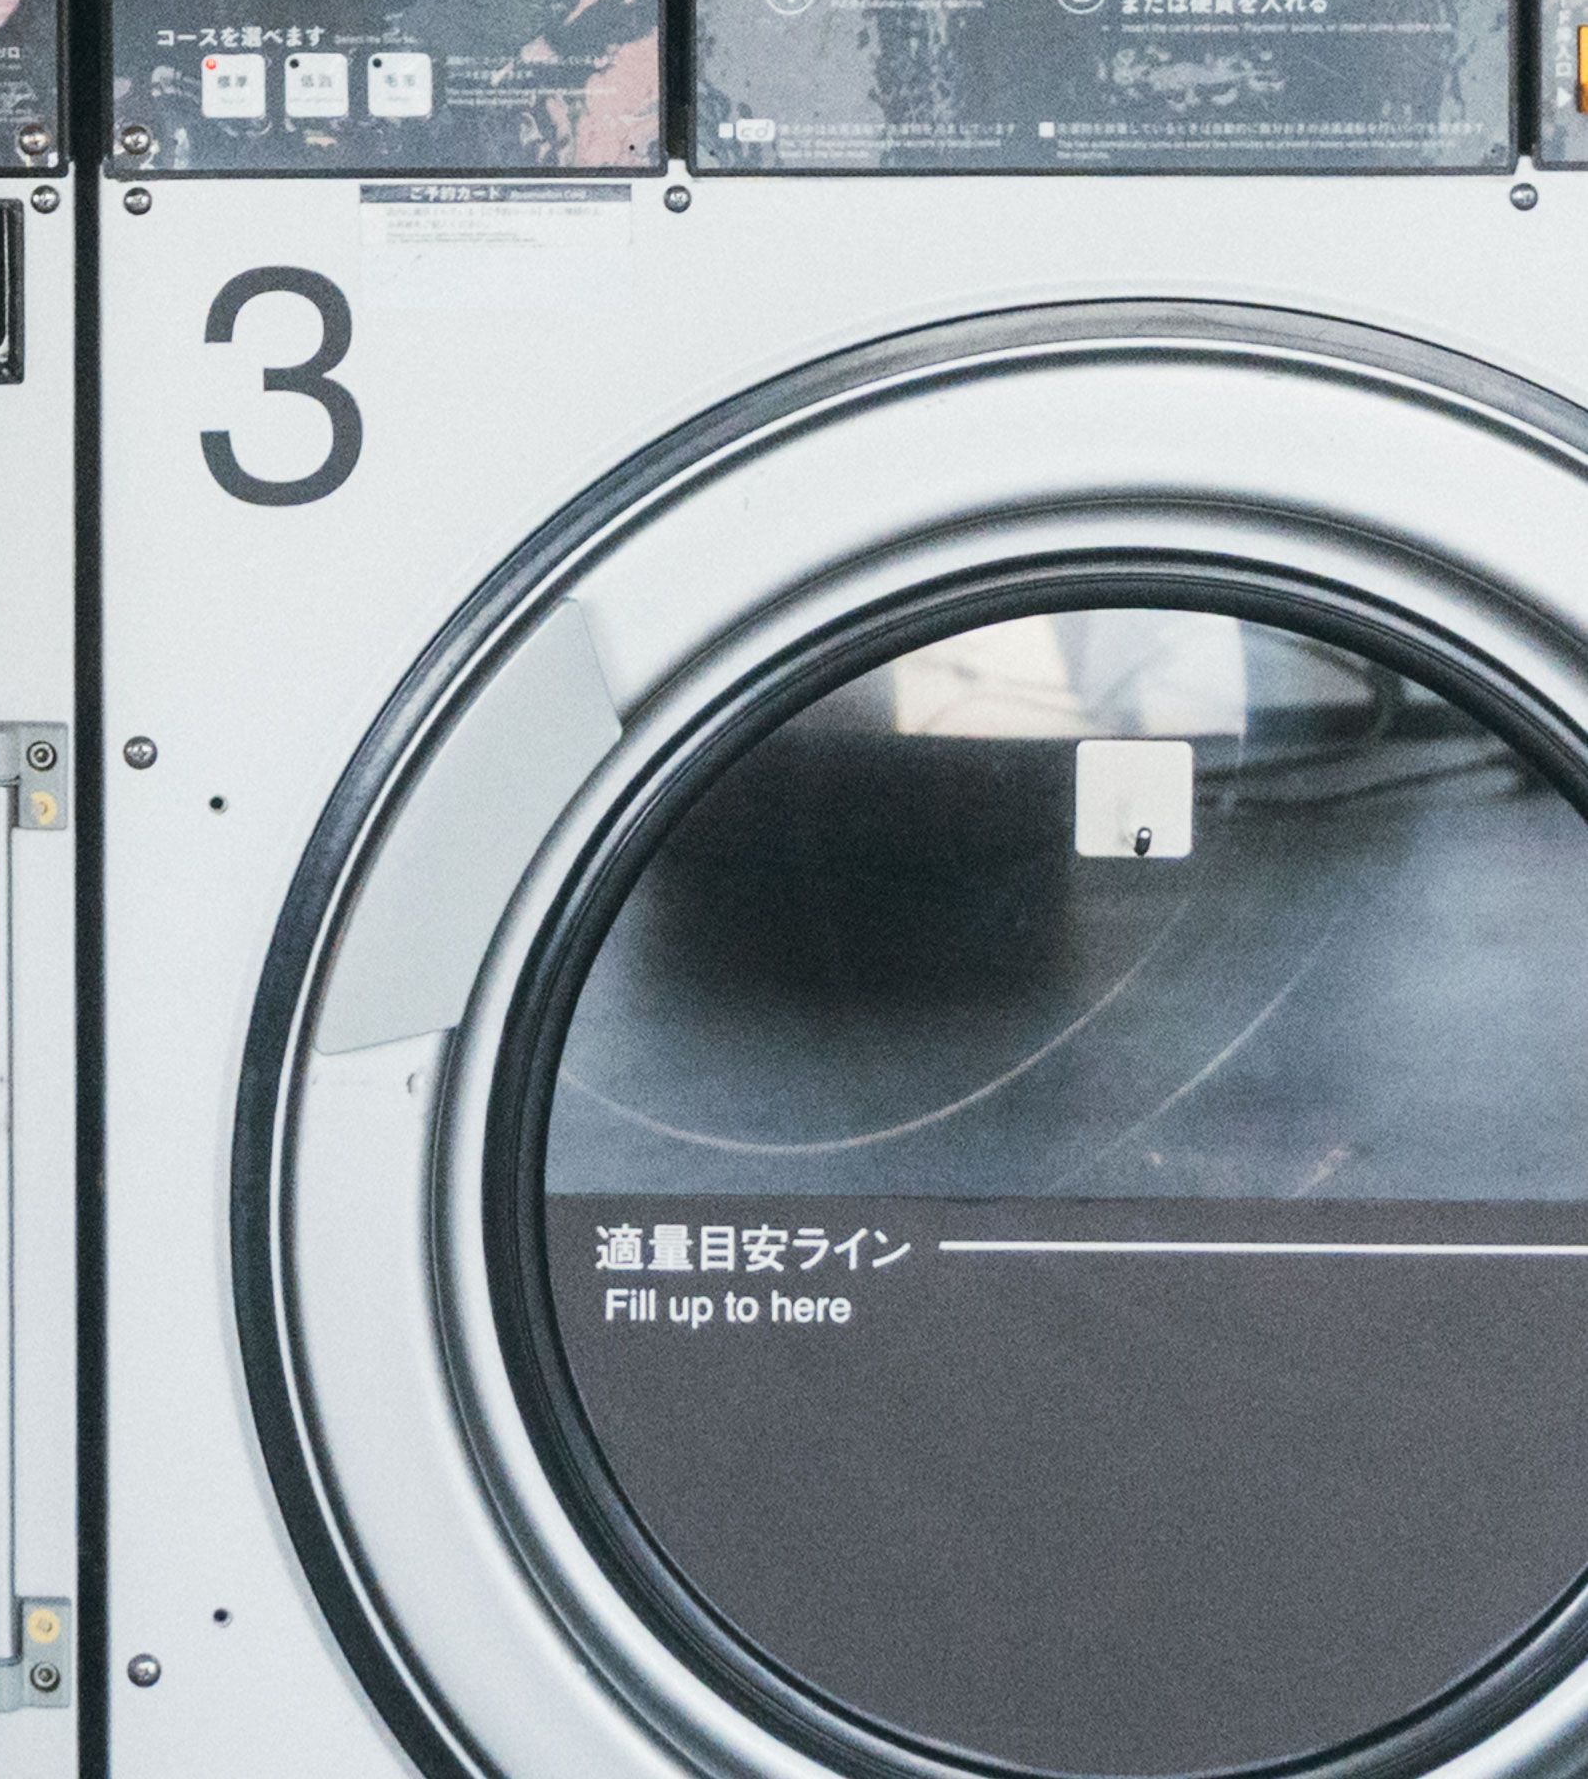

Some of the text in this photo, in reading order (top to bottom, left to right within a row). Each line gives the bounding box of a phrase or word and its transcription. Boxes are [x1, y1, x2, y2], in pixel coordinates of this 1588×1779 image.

[158, 27, 324, 47] コースを選べます
[200, 266, 363, 507] 3
[596, 1224, 910, 1271] 適量目安ライン
[606, 1289, 851, 1329] Fill up to here
